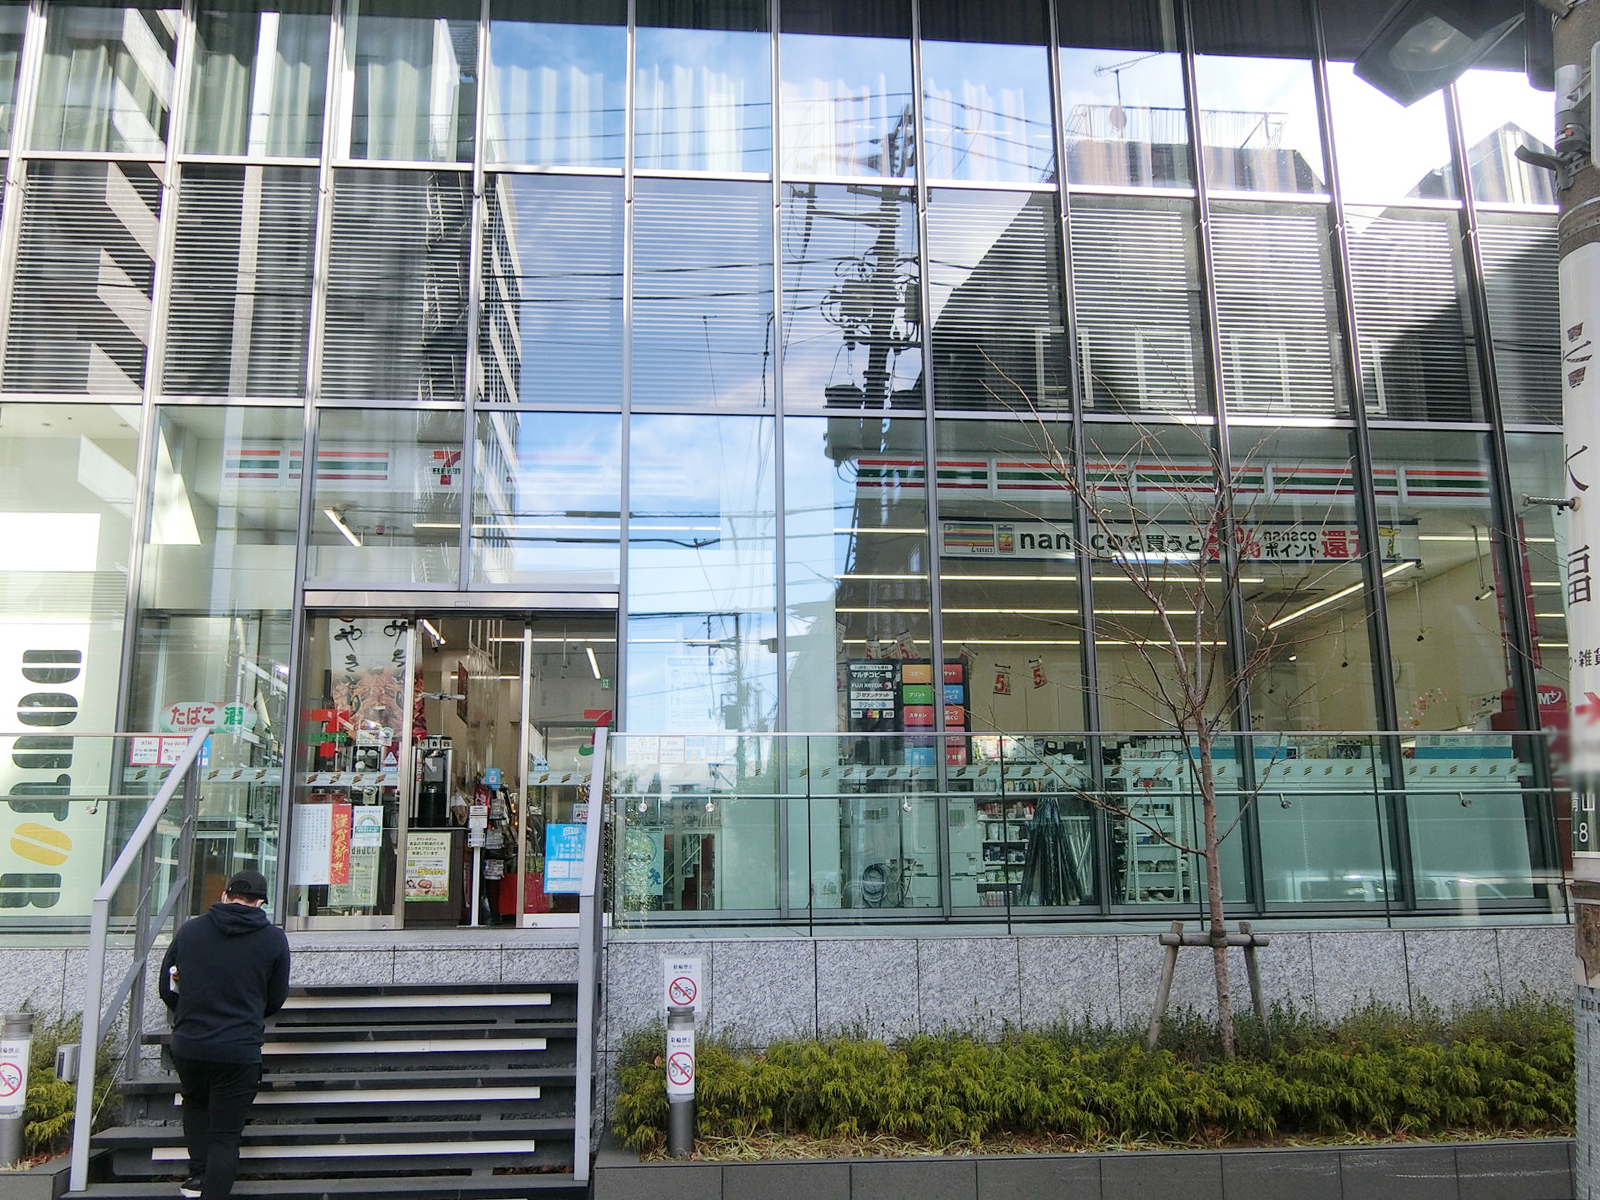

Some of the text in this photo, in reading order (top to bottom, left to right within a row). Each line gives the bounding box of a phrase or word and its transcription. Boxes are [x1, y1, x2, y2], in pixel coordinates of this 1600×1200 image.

[171, 706, 244, 725] たばこ 酒
